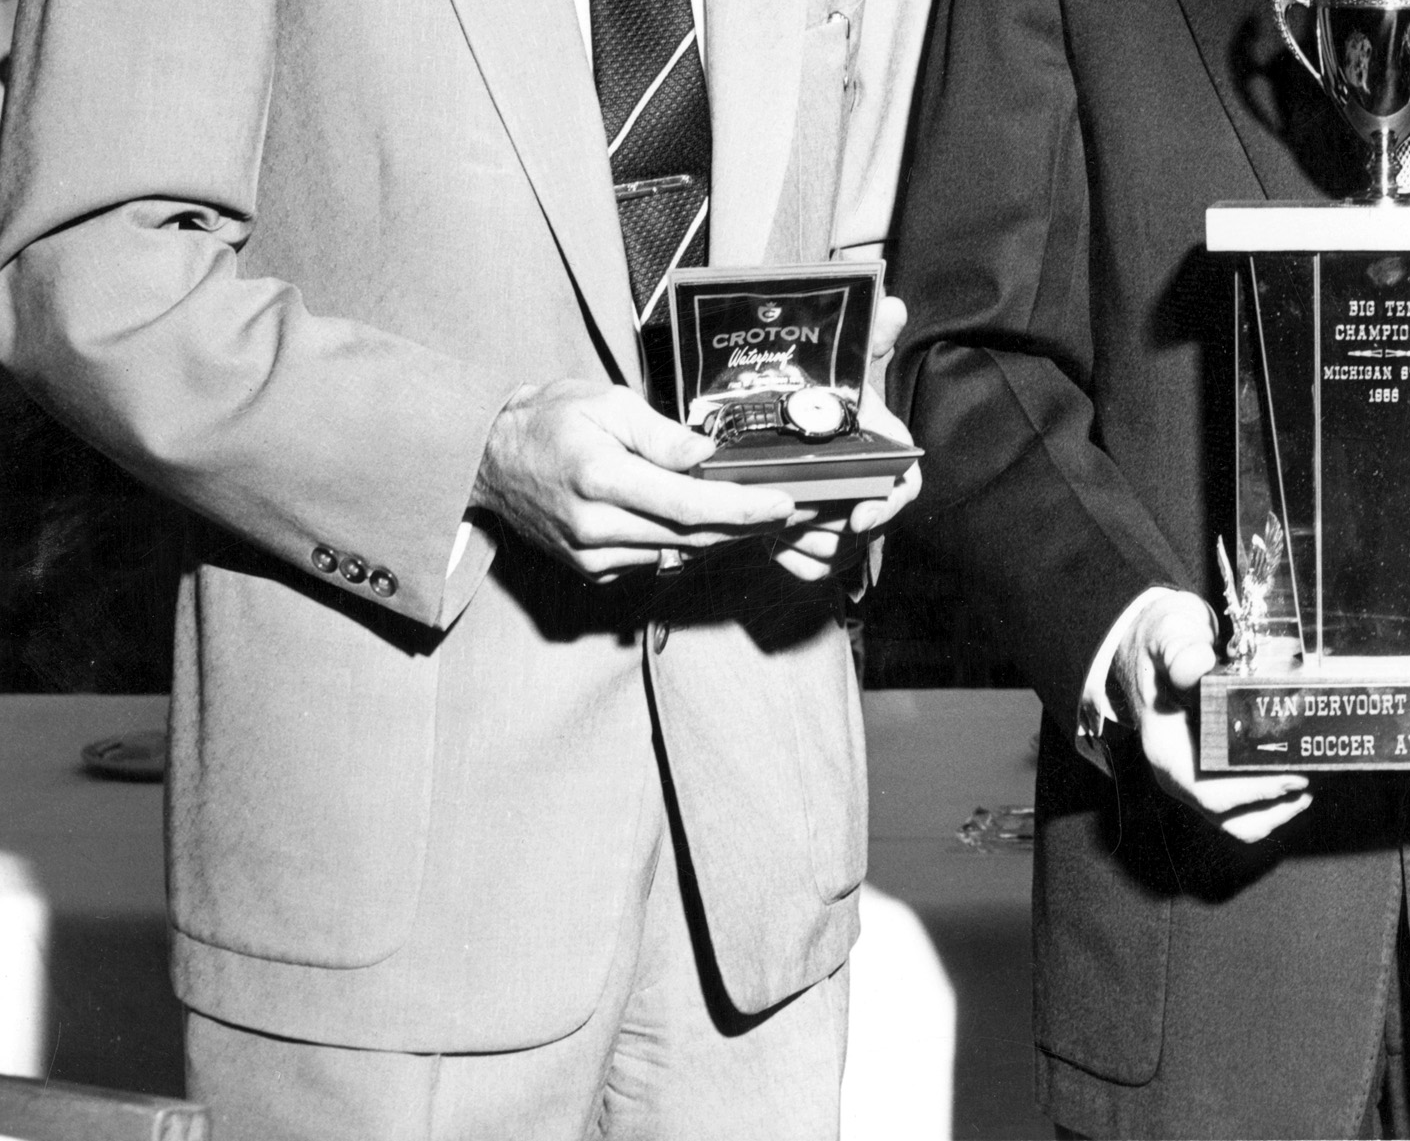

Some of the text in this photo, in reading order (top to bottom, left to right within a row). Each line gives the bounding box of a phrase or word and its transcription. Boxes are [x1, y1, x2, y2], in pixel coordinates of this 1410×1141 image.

[1349, 301, 1374, 316] BIG
[712, 326, 820, 349] CROTON
[728, 344, 796, 371] Waterproof
[1324, 366, 1392, 379] MICHIGAN
[1256, 696, 1299, 717] VAN
[1303, 694, 1407, 716] DERVOORT
[1300, 735, 1375, 757] SOCCER
